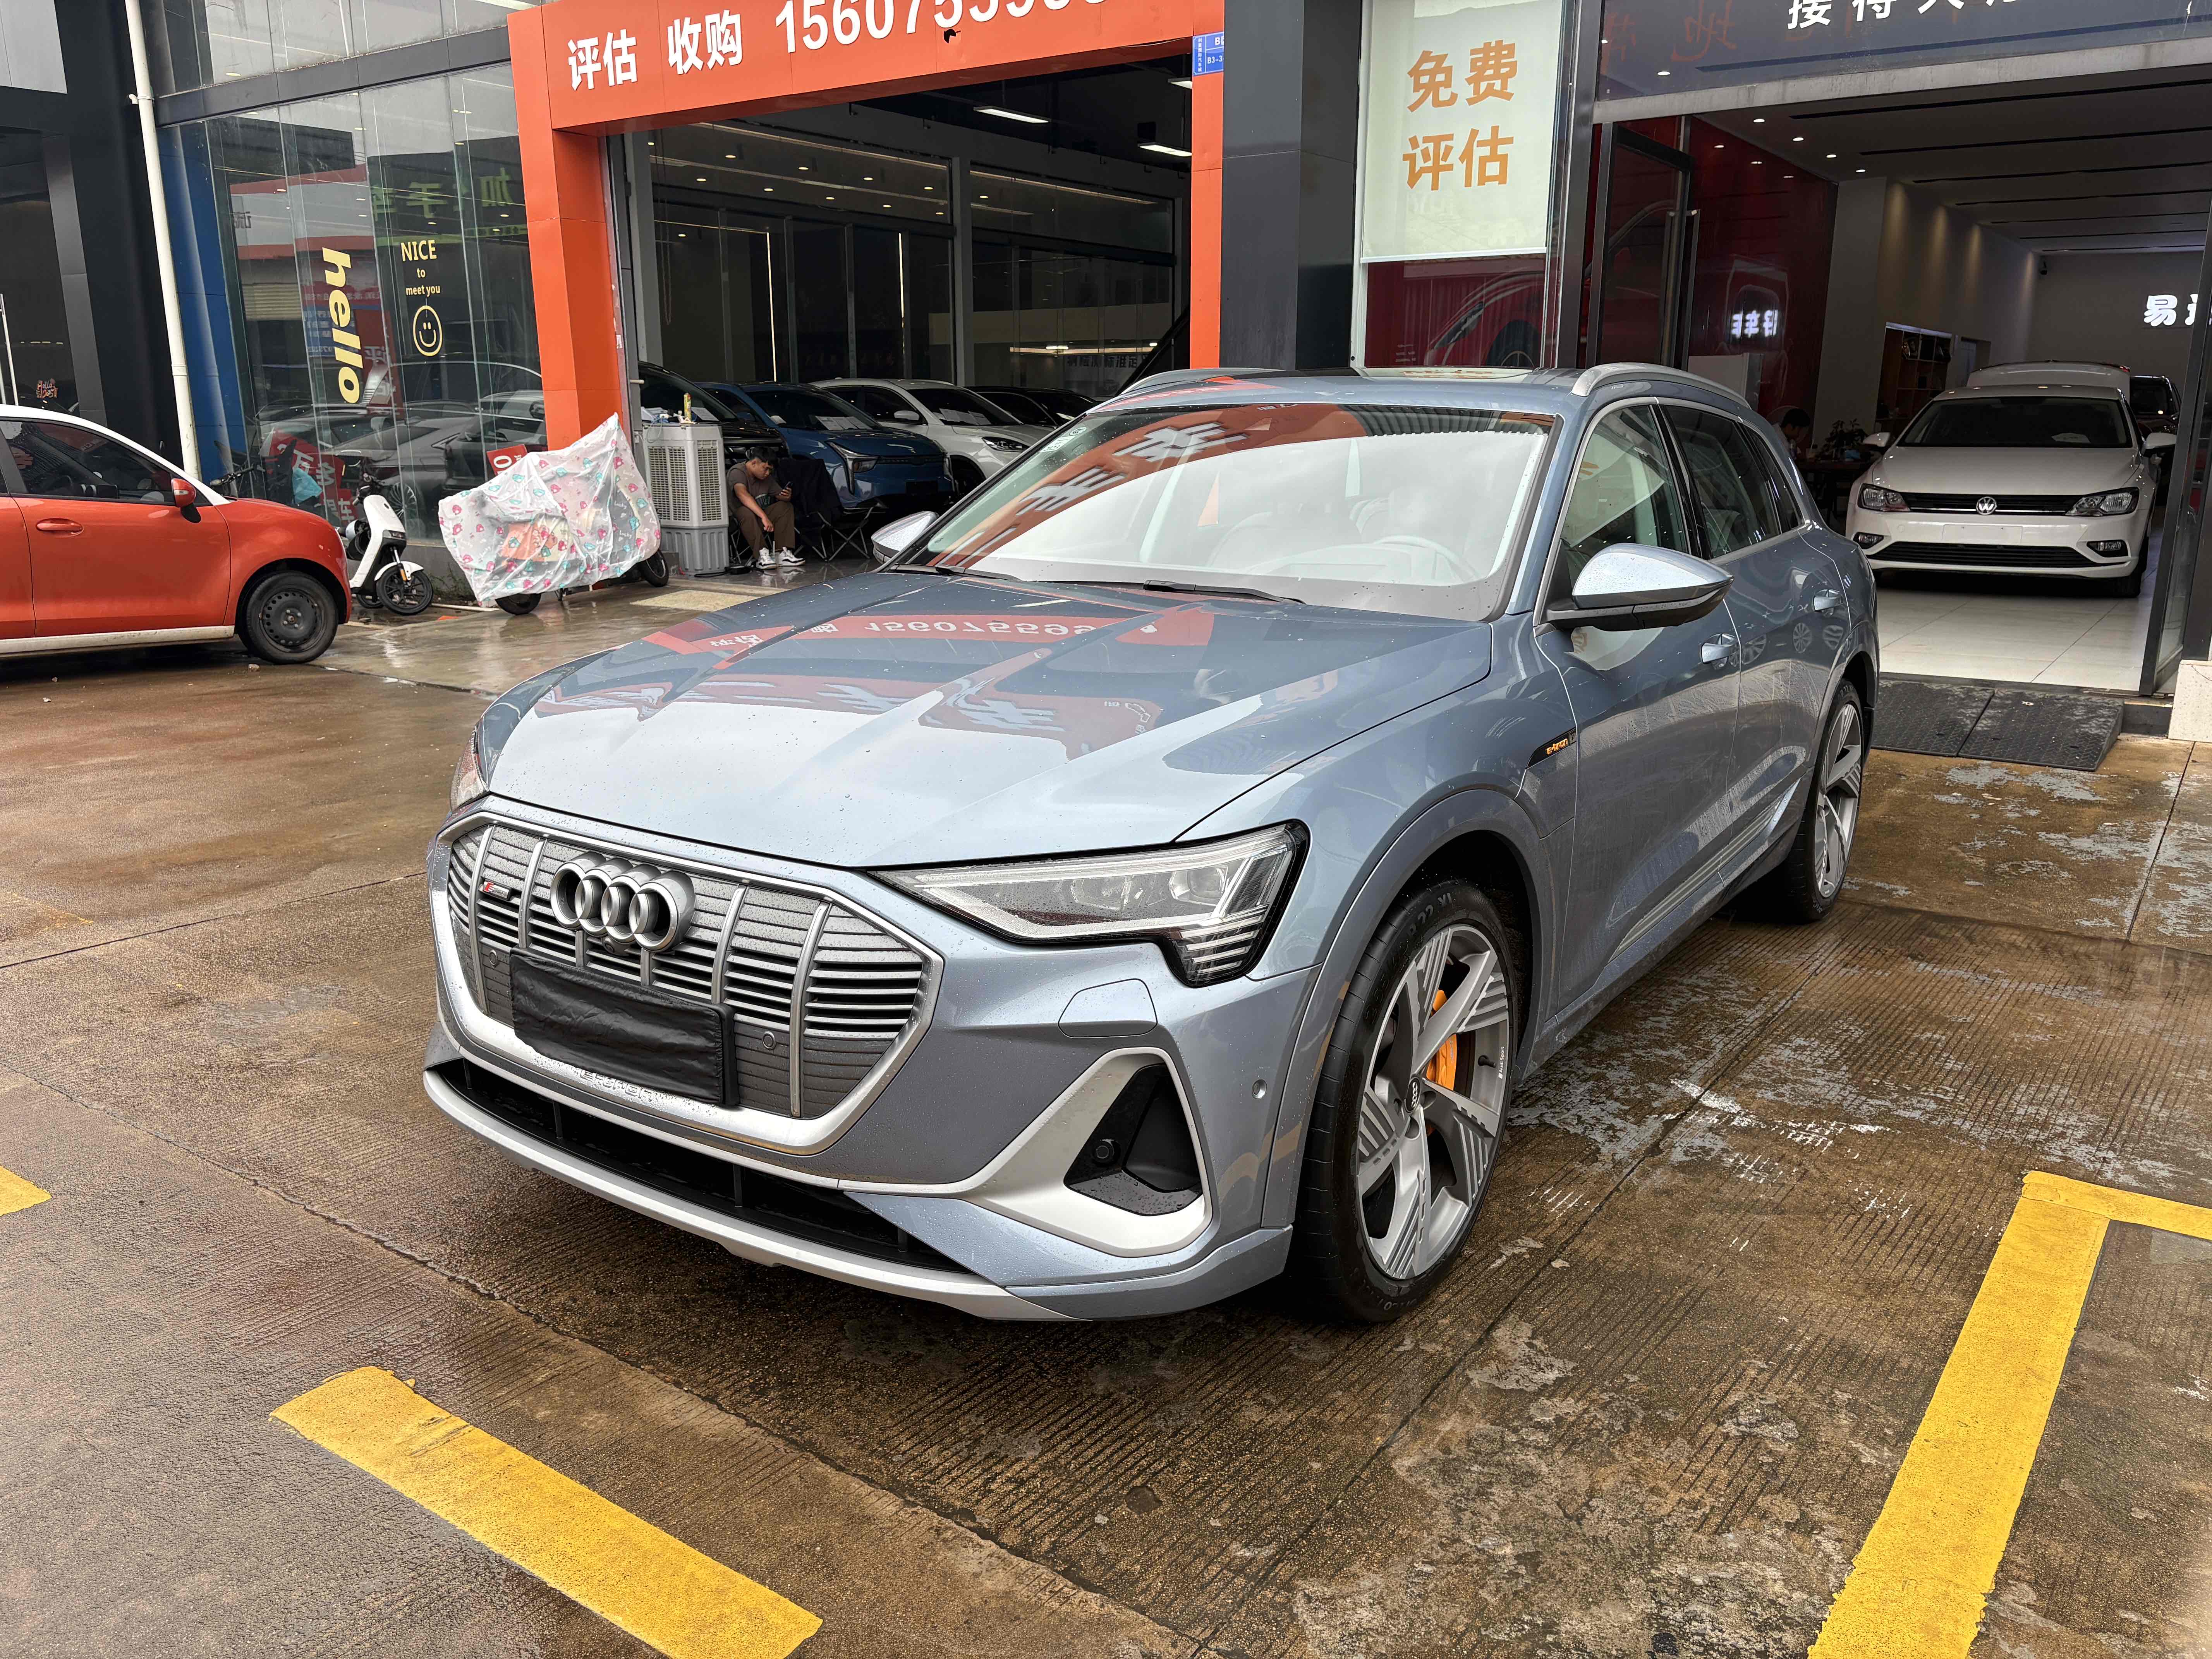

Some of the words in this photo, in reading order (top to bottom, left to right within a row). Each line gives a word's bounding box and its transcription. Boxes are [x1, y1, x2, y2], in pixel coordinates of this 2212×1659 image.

[567, 29, 637, 91] 评估
[667, 10, 743, 75] 收购
[1207, 55, 1224, 64] B3-3
[1407, 40, 1518, 112] 免费
[1403, 125, 1514, 191] 评估
[401, 240, 437, 262] NICE
[416, 268, 426, 278] to
[405, 285, 425, 296] meet
[425, 284, 441, 297] you
[322, 247, 363, 404] hello
